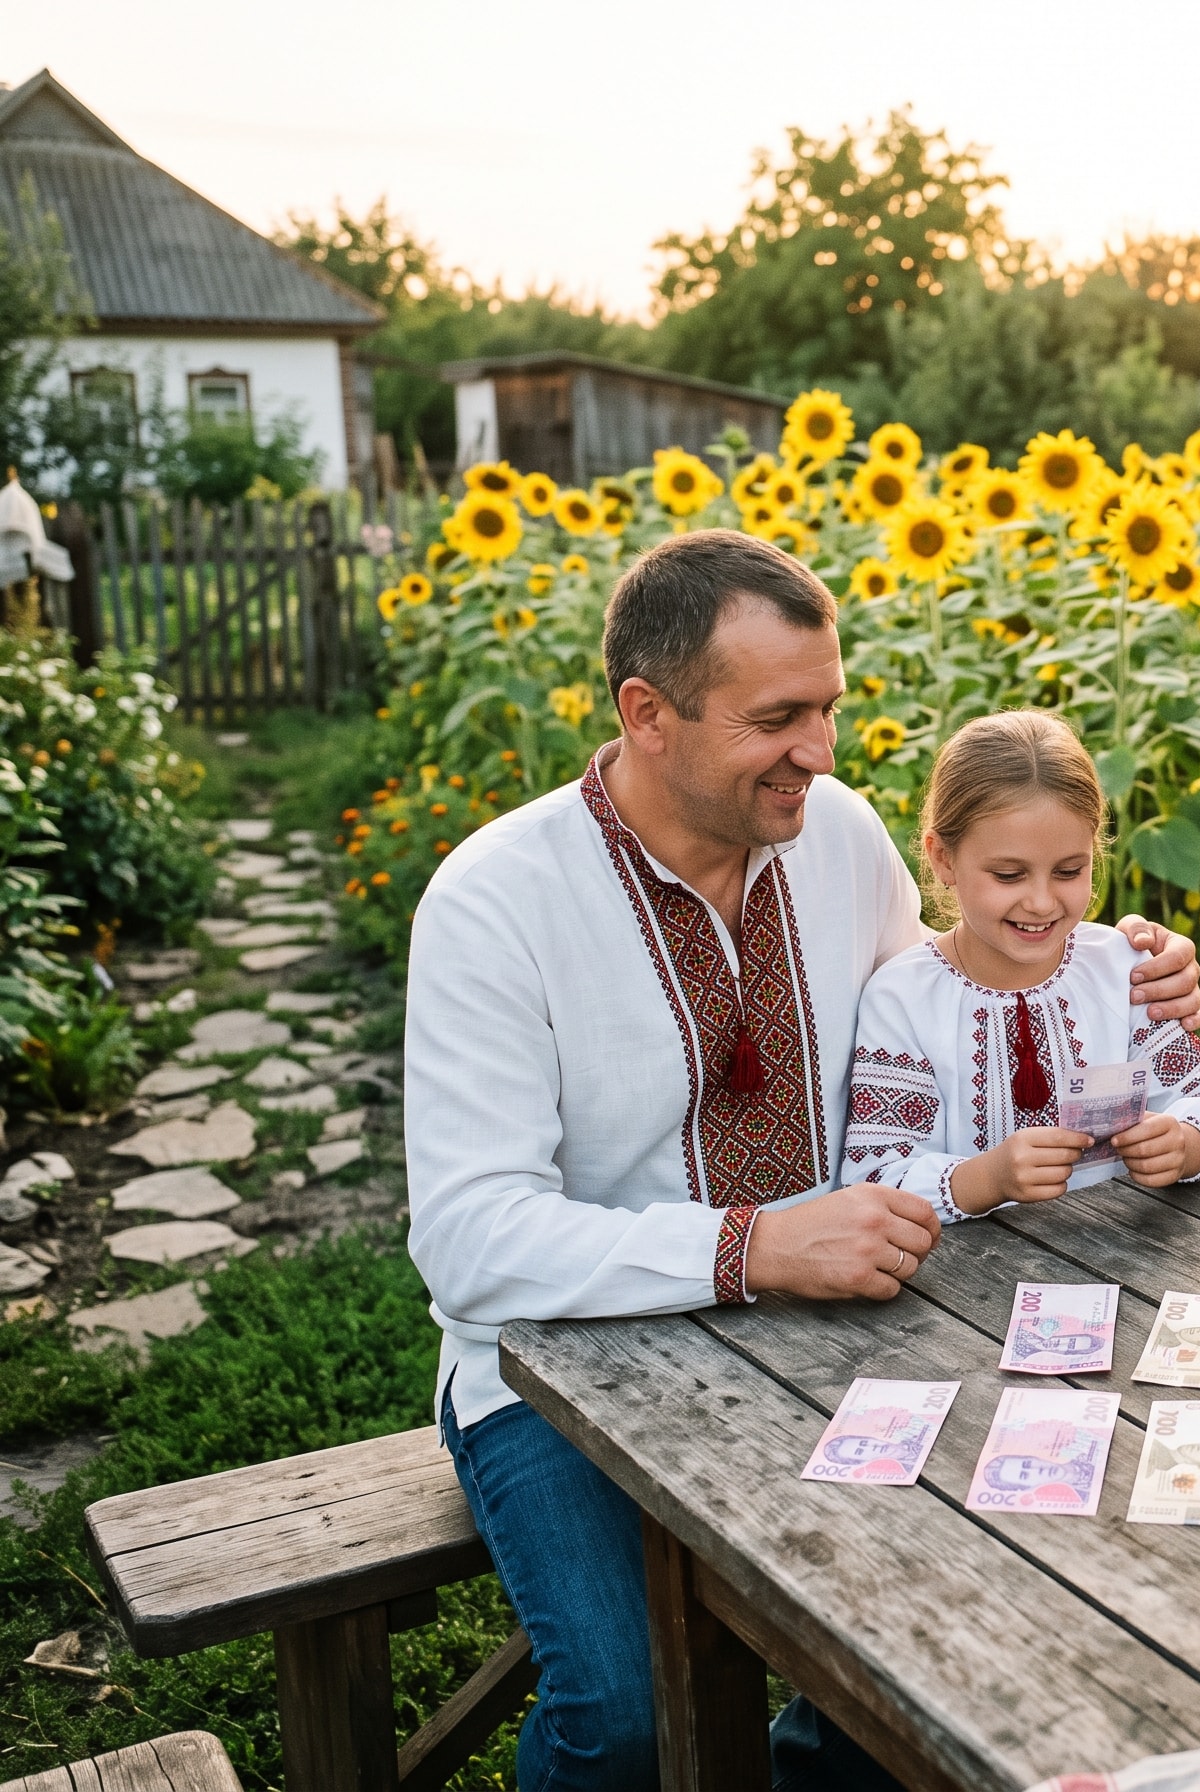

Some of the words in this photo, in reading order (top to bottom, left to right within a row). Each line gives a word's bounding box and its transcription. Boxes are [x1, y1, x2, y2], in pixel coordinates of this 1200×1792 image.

[1070, 1078, 1084, 1094] 50
[1021, 1291, 1042, 1312] 200
[923, 1387, 951, 1410] 200
[1083, 1397, 1110, 1423] 200
